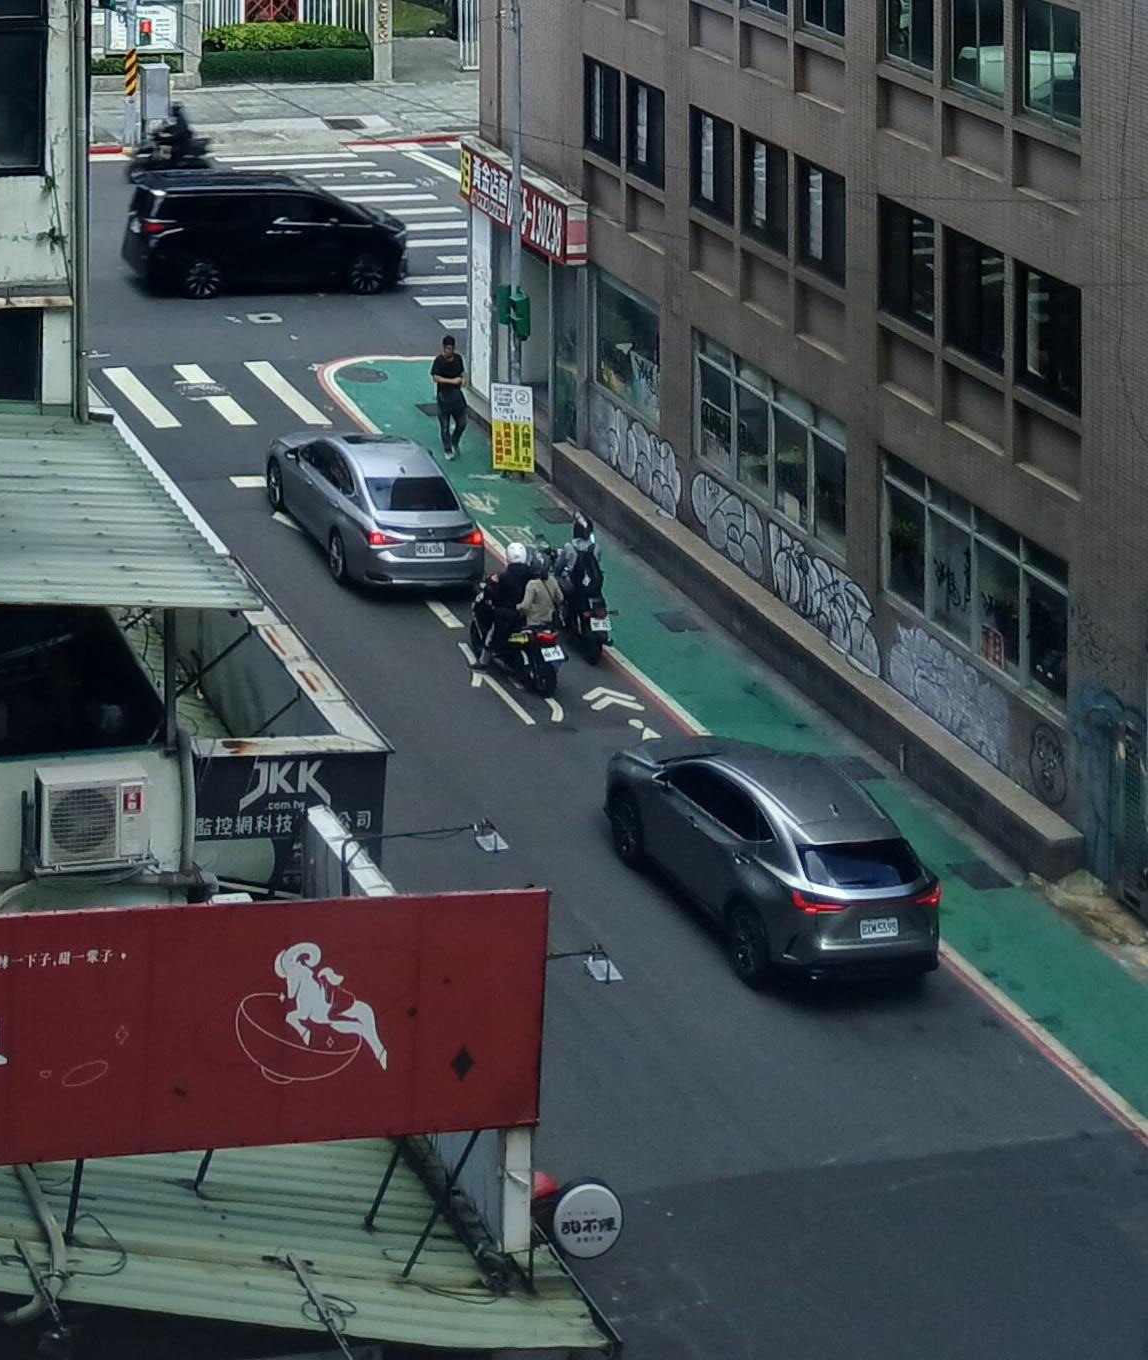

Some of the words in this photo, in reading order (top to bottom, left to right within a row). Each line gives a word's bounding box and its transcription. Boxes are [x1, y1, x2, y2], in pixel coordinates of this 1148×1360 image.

[239, 760, 331, 811] JKK
[561, 1217, 618, 1235] 甜不辣
